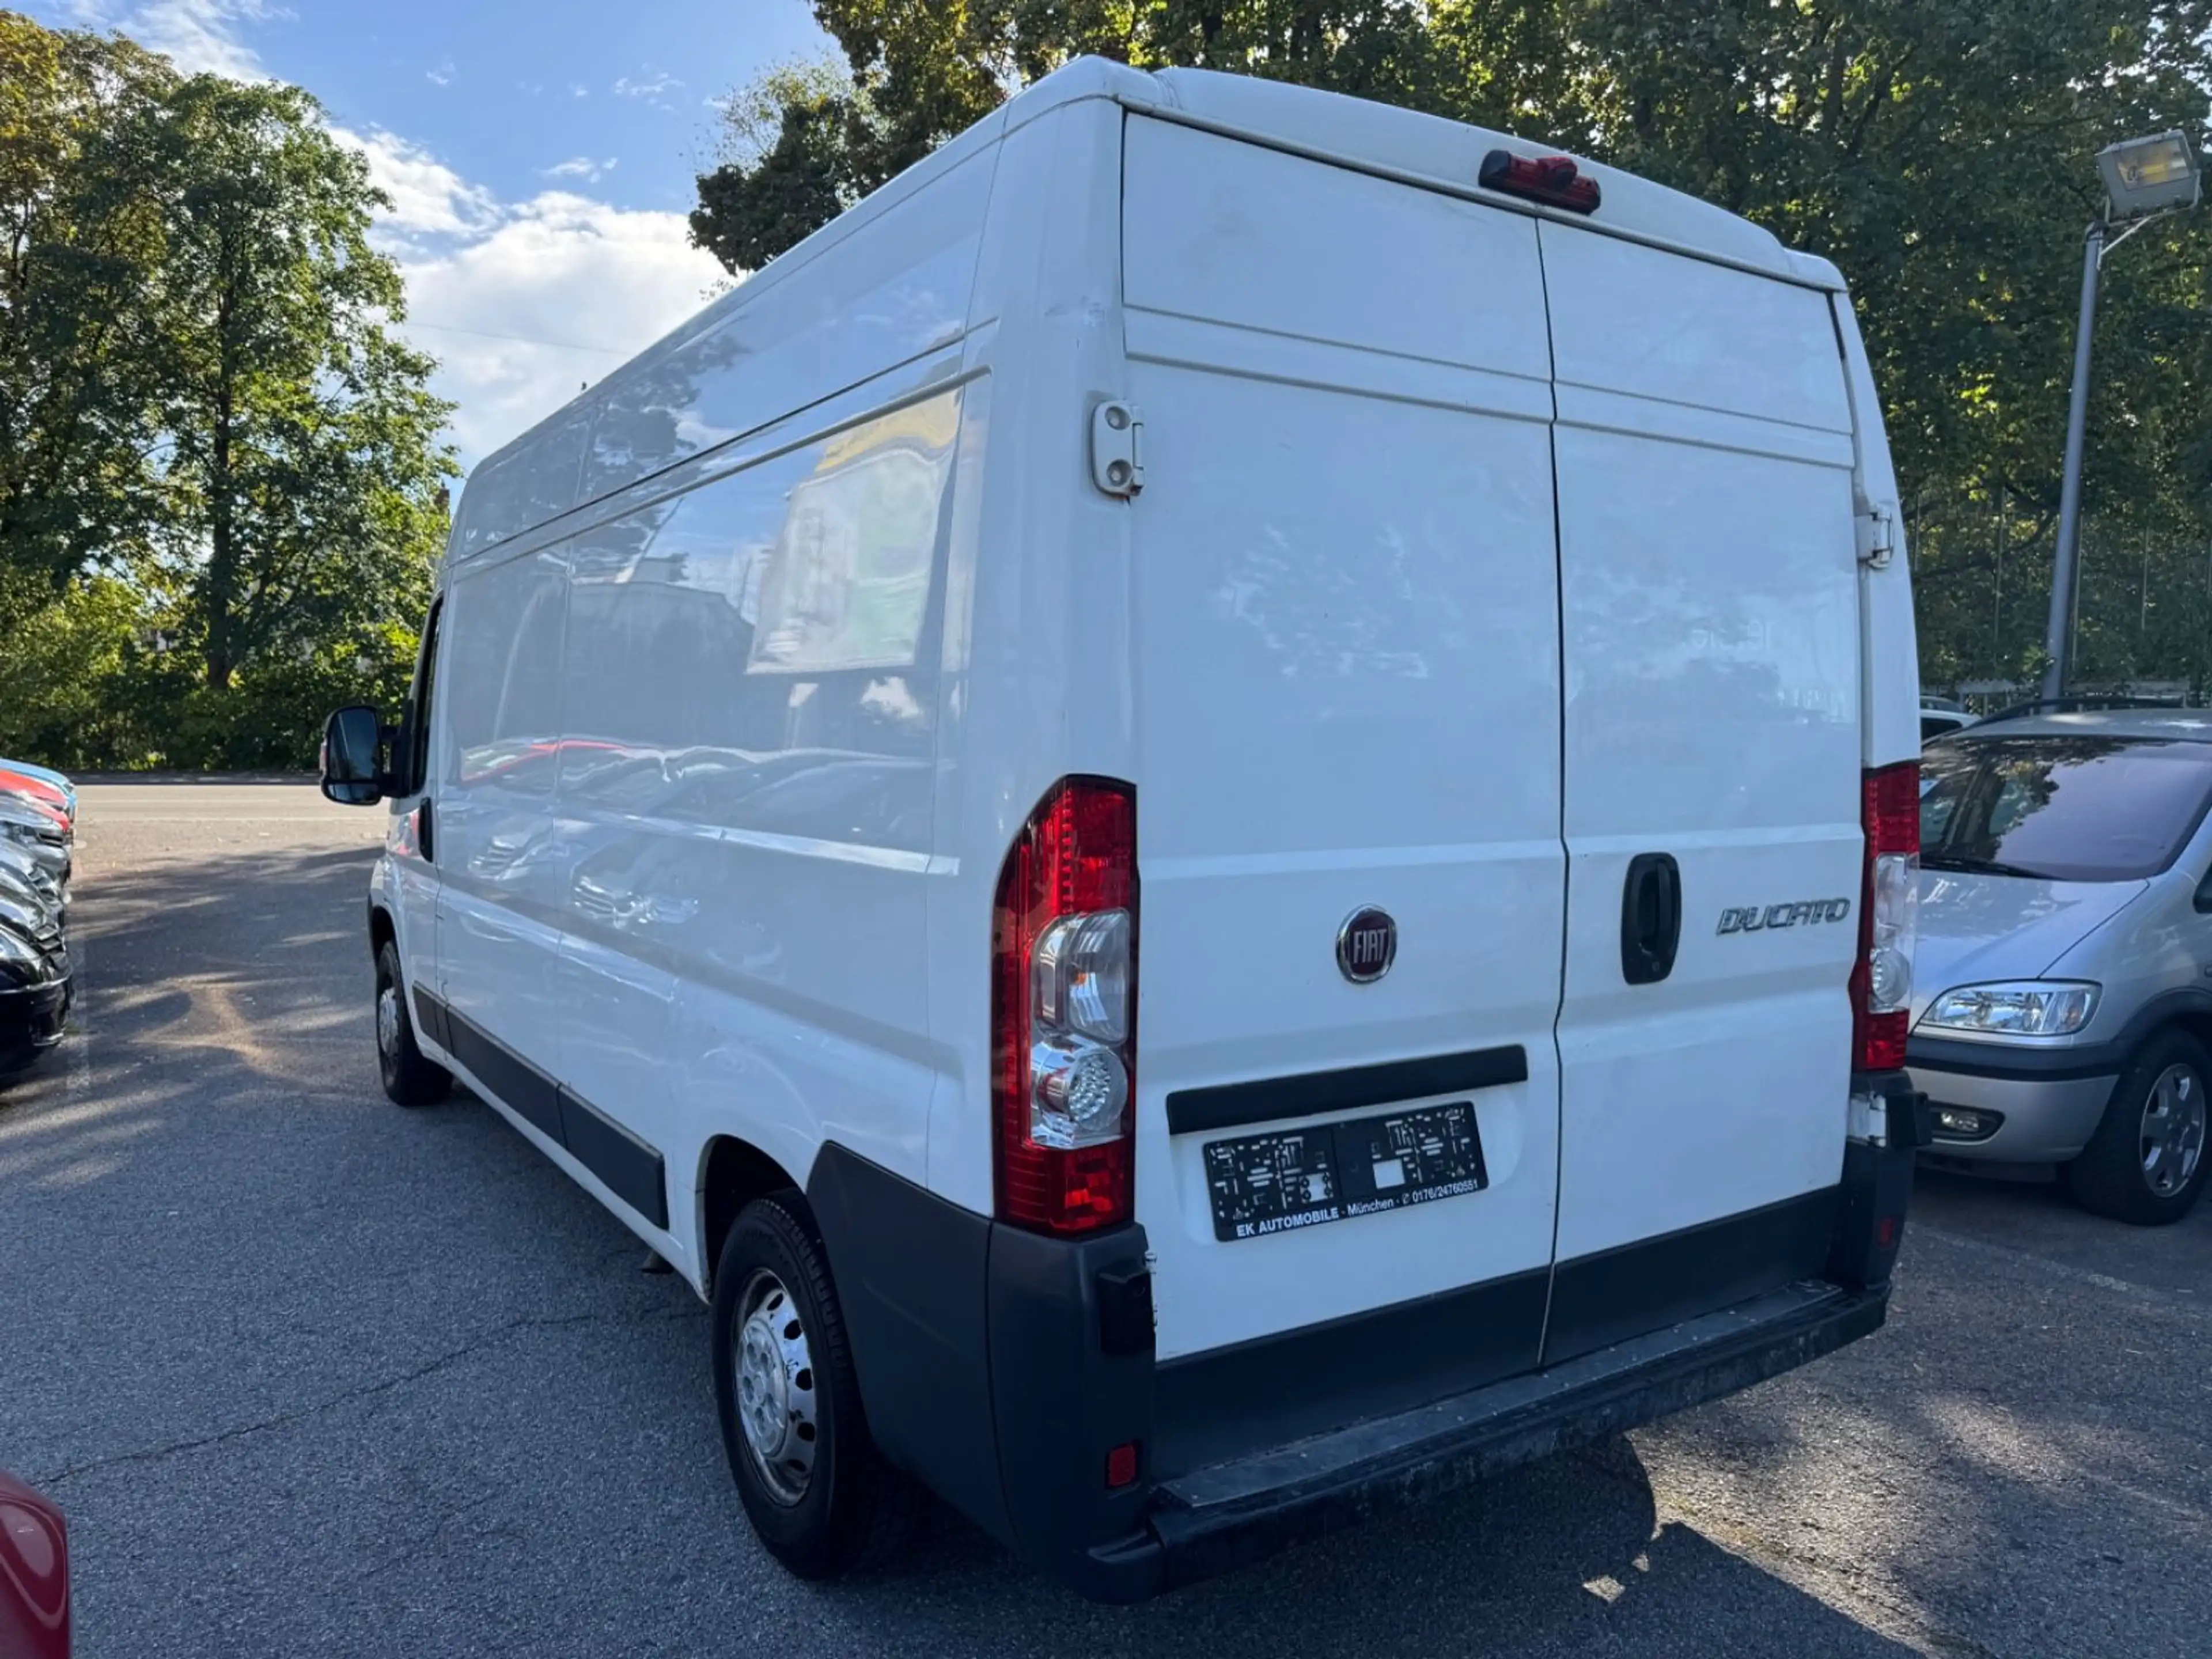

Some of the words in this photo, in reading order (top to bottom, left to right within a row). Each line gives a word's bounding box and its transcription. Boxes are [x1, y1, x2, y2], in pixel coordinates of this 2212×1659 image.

[1716, 897, 1850, 936] DUCATO
[1353, 928, 1387, 964] FIAT
[1236, 1222, 1255, 1237] EK
[1259, 1207, 1339, 1234] AUTOMOBILE
[1347, 1198, 1395, 1217] München
